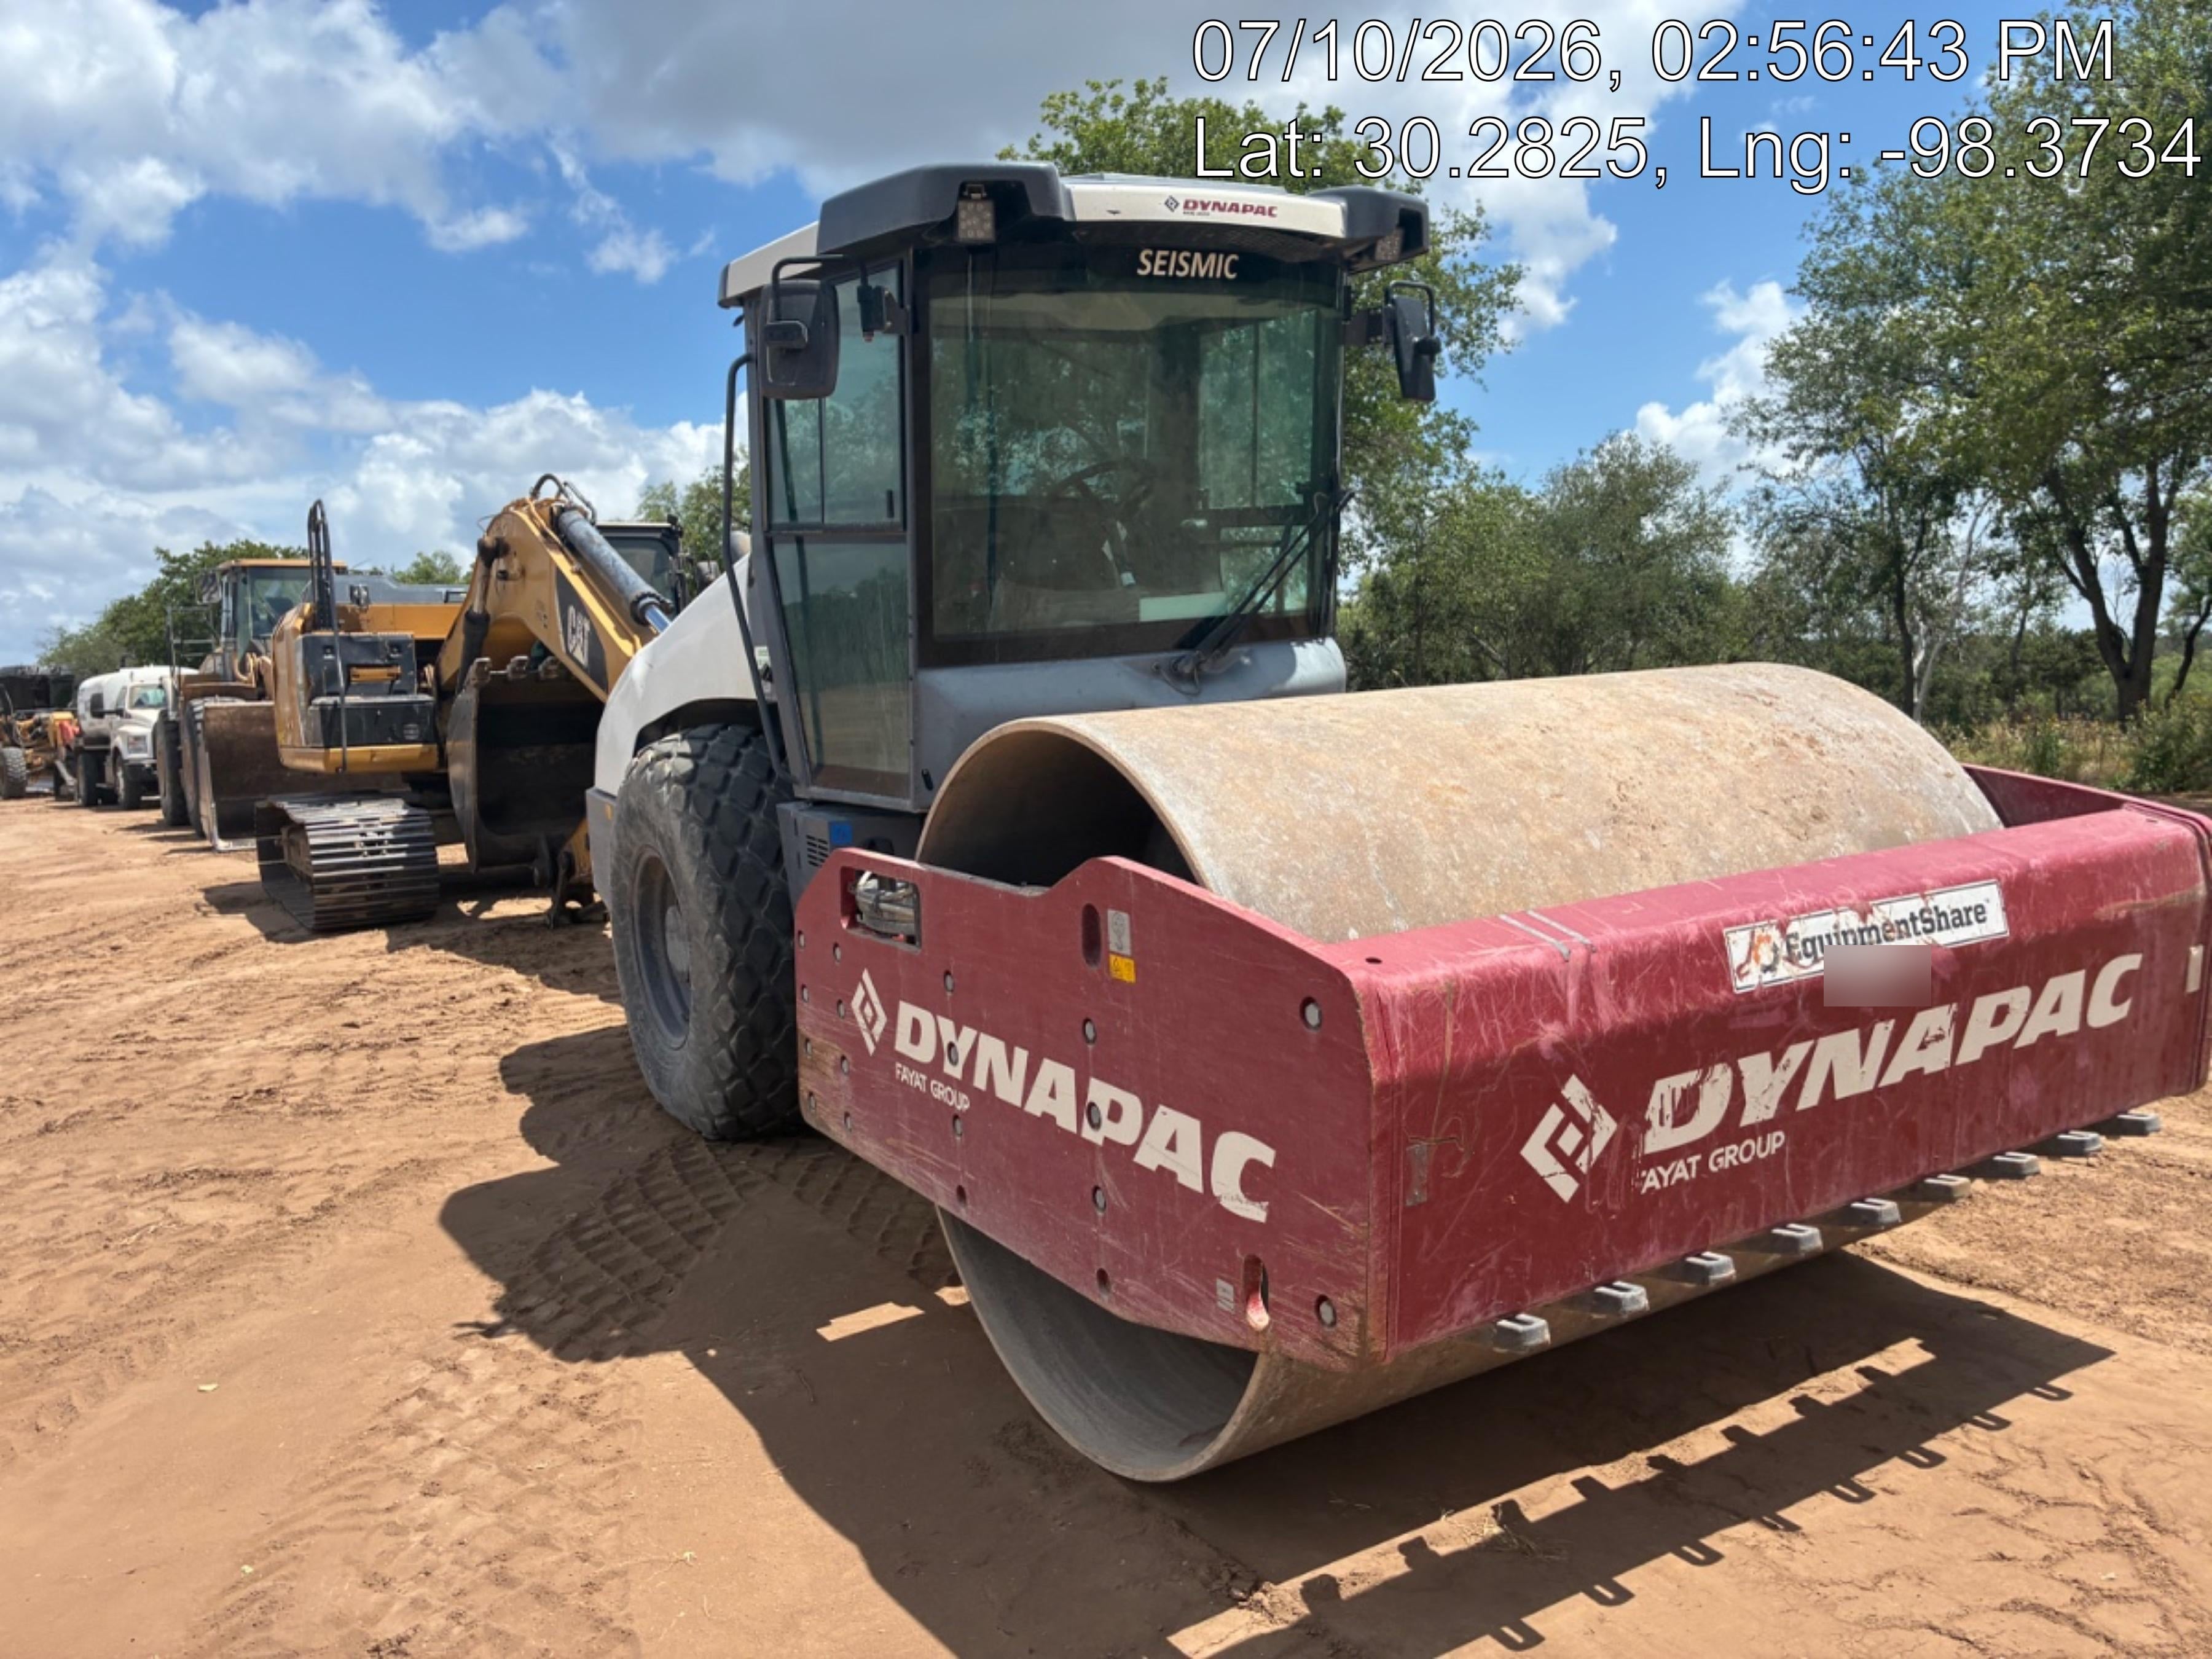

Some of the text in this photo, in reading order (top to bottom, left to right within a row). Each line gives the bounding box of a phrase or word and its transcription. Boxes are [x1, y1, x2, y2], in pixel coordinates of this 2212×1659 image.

[1183, 199, 1277, 218] DYNAPAC
[1137, 248, 1239, 279] SEISMIC
[568, 604, 590, 667] CAT
[1644, 954, 2143, 1155] DYNAPAC
[894, 1000, 1276, 1223] DYNAPAC
[895, 1061, 970, 1112] FAYAT GROUP
[1637, 1131, 1786, 1194] AYAT GROUP
